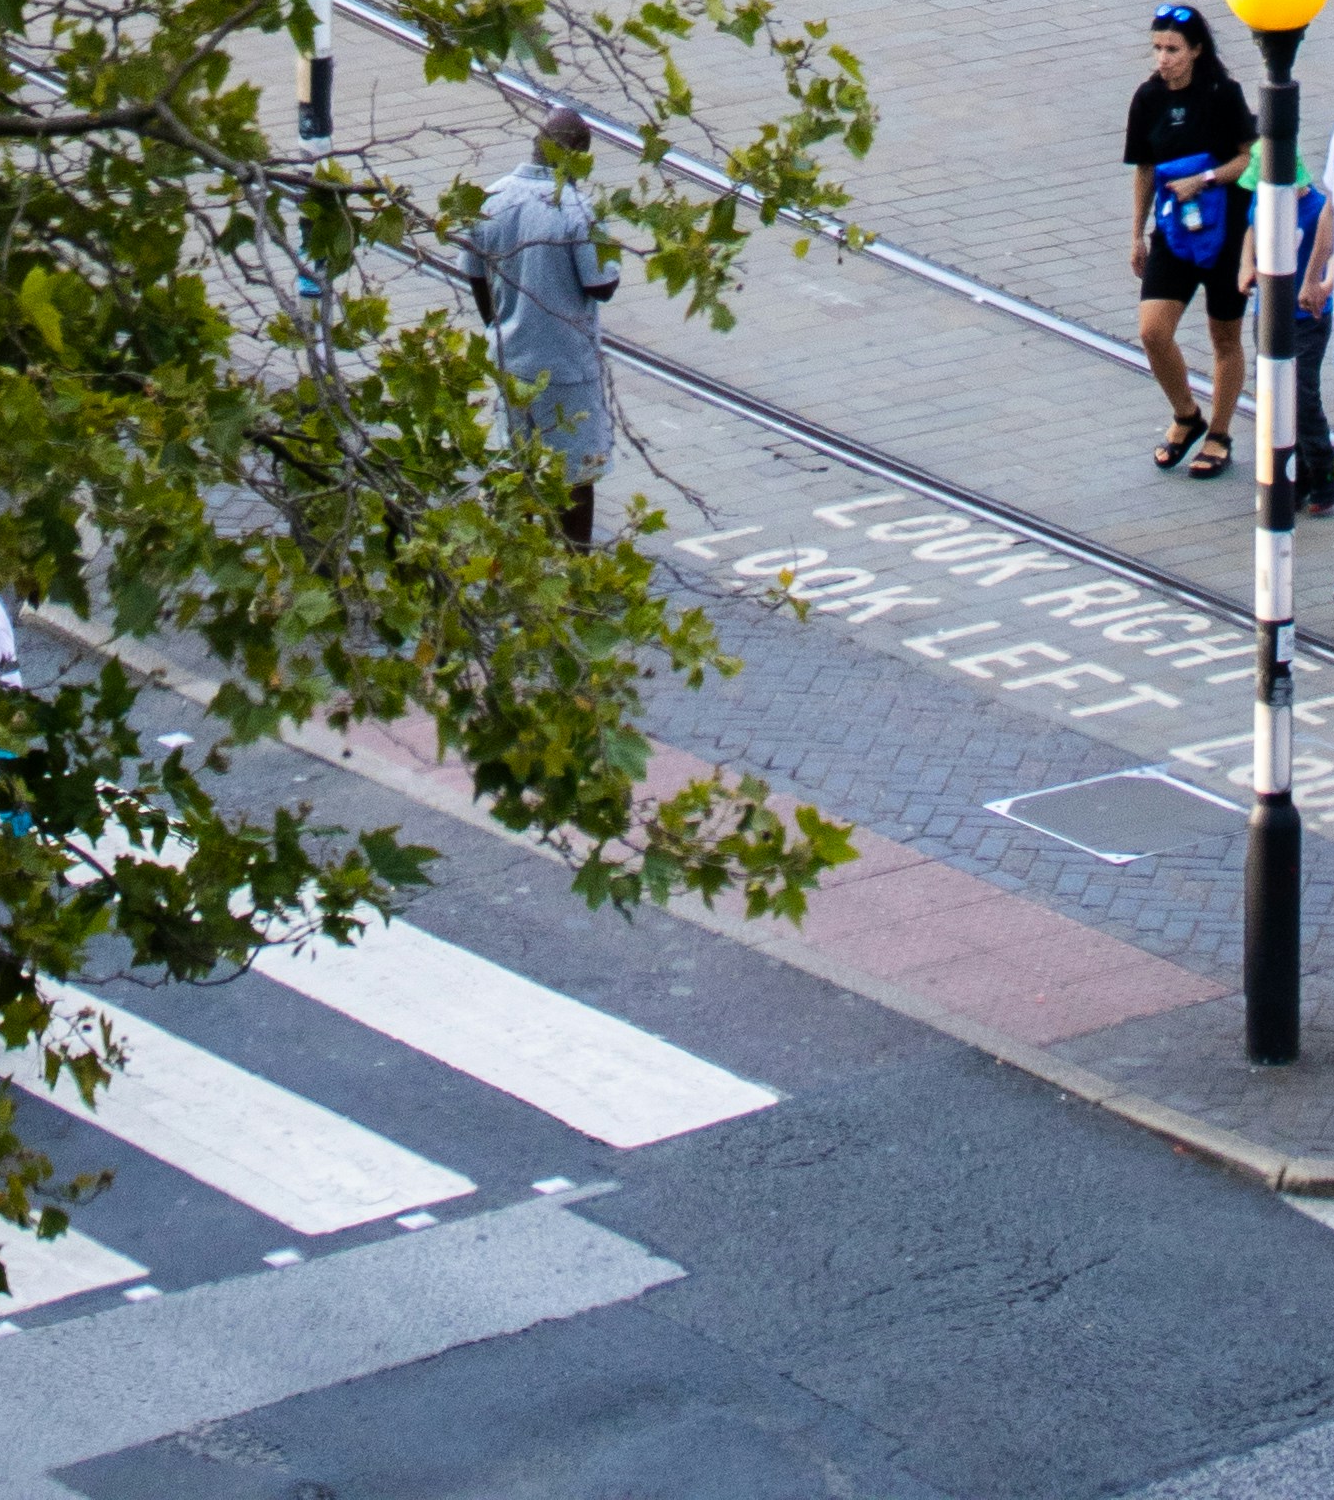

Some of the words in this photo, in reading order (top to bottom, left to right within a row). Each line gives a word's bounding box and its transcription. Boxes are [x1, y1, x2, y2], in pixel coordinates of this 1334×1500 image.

[812, 493, 1072, 587] LOOK
[673, 525, 942, 624] LOOK
[901, 620, 1182, 718] LEFT
